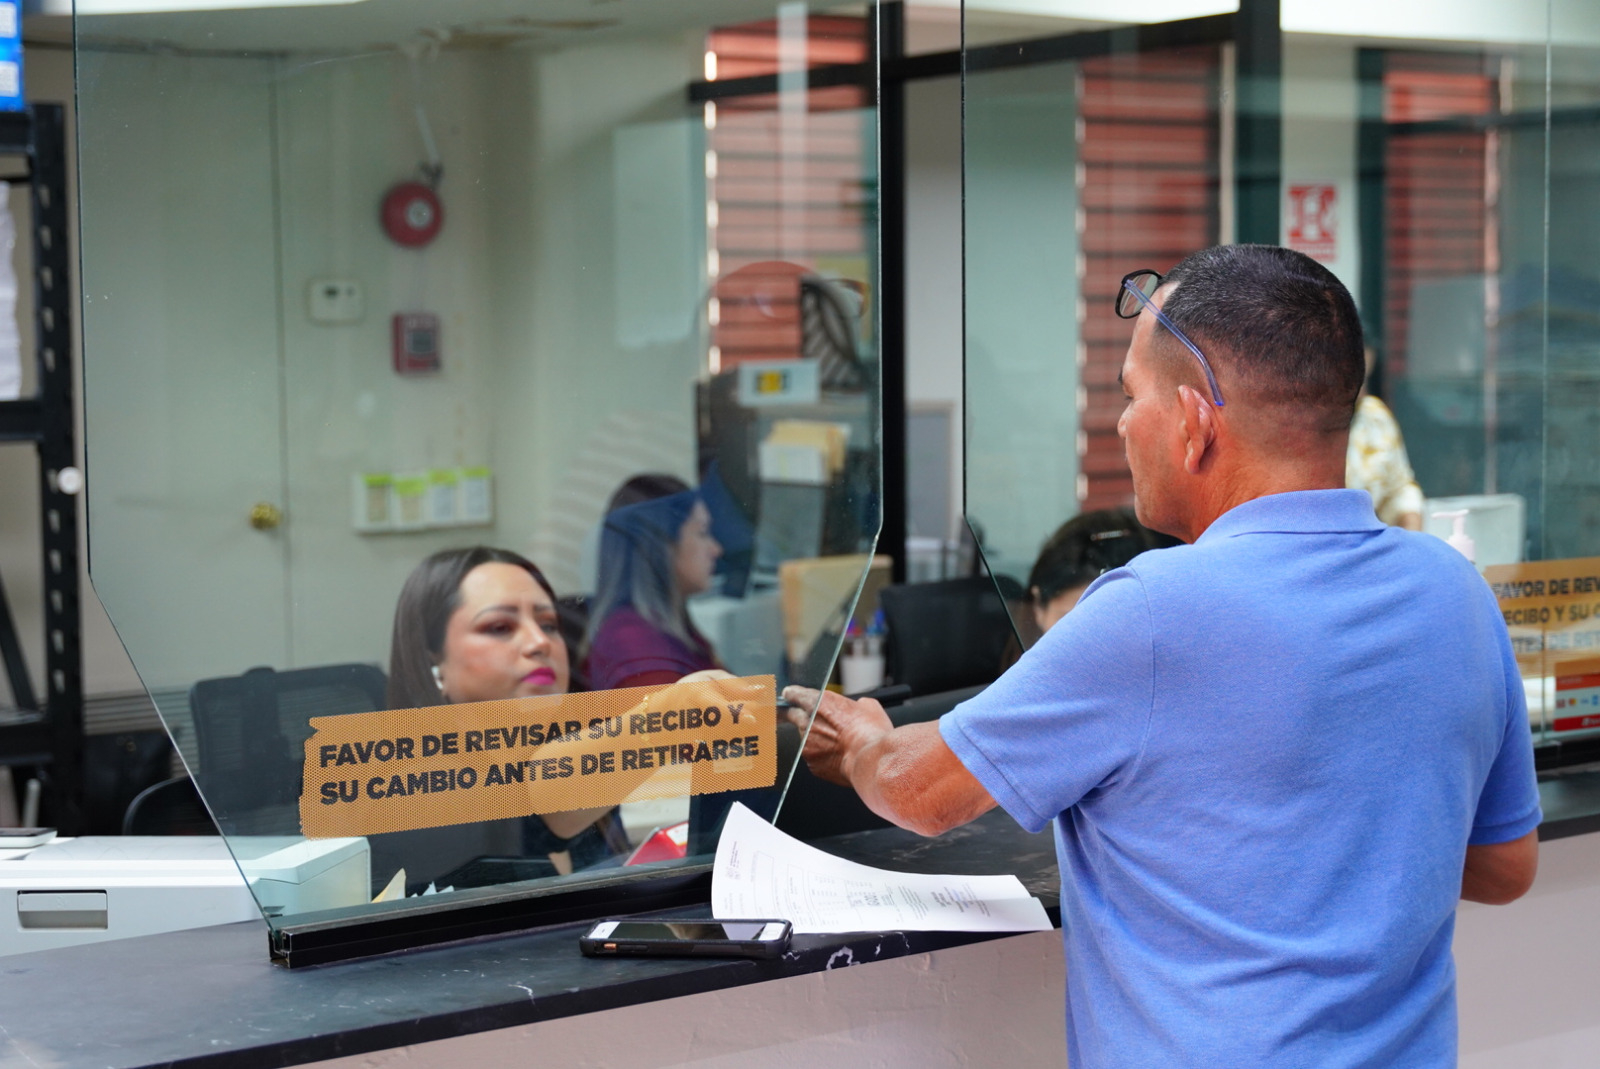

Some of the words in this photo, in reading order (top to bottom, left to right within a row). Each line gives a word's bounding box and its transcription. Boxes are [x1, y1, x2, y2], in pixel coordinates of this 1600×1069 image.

[1549, 578, 1569, 595] DE
[1502, 607, 1550, 626] ECIBO
[1554, 605, 1565, 621] Y
[1569, 603, 1590, 621] SU
[320, 736, 415, 768] FAVOR
[422, 732, 459, 757] DE
[465, 720, 582, 753] REVISAR
[588, 716, 622, 740] SU
[630, 706, 721, 736] RECIBO
[728, 703, 744, 724] Y
[320, 779, 359, 805] SU
[366, 767, 478, 800] CAMBIO
[484, 756, 574, 787] ANTES
[581, 751, 615, 776] DE
[622, 735, 759, 771] RETIRARSE
